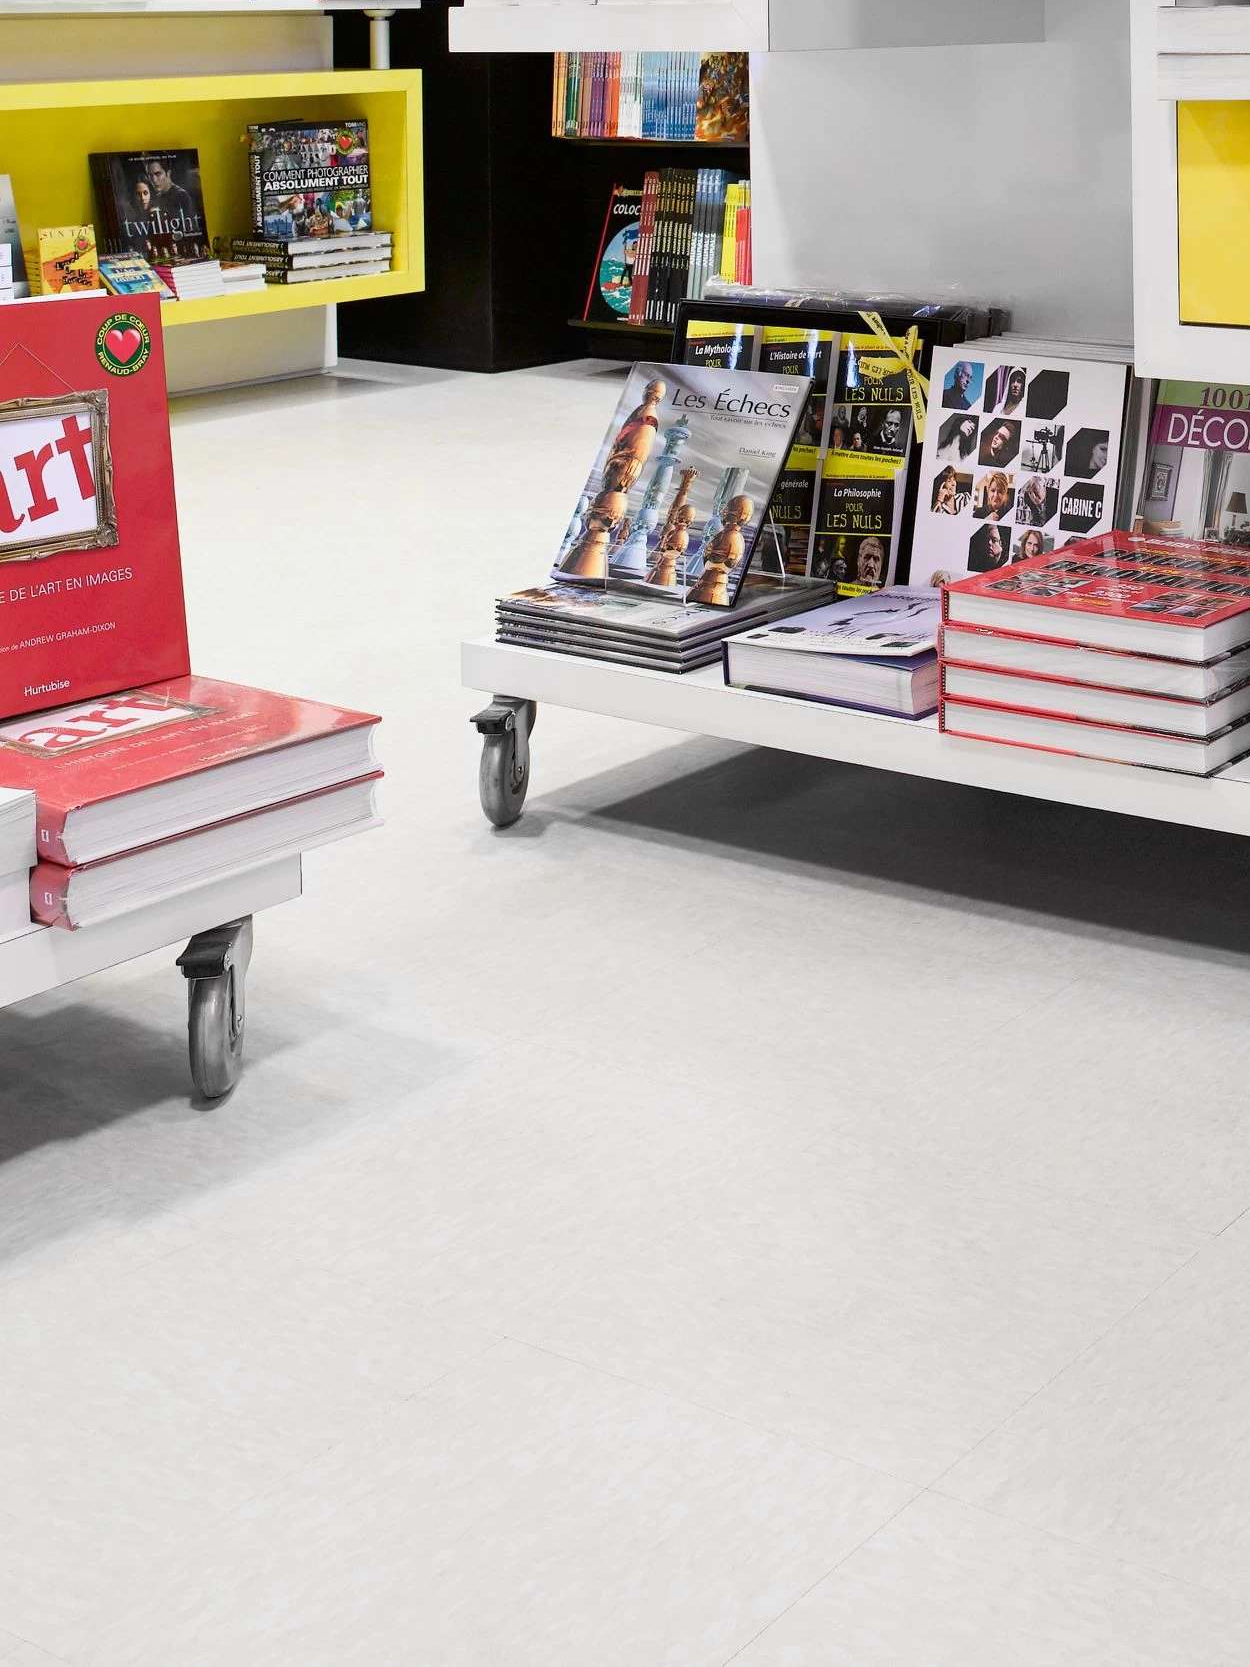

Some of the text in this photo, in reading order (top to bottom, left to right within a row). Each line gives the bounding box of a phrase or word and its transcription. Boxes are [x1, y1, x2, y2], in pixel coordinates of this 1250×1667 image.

[263, 164, 369, 182] COMMENT PHOTOGRAPHIER
[264, 174, 369, 191] ABSOLUMENT TOUT
[124, 207, 201, 238] twilight
[97, 318, 113, 345] COUP
[695, 345, 704, 355] La
[770, 350, 796, 361] L'Histoire
[97, 348, 150, 375] RENAUD-BRAY
[845, 386, 904, 402] LES NULS
[671, 389, 792, 418] Les Échecs
[738, 447, 760, 455] Daniel
[780, 479, 809, 490] générale
[833, 487, 882, 500] La Philosophie
[845, 503, 864, 513] POUR
[1062, 496, 1095, 518] CABINE
[826, 514, 882, 530] LES NULS
[9, 567, 133, 602] DE L'ART EN IMAGES
[19, 622, 116, 648] ANDREW GRAHAM-DIXON
[24, 679, 70, 697] Hurtubise
